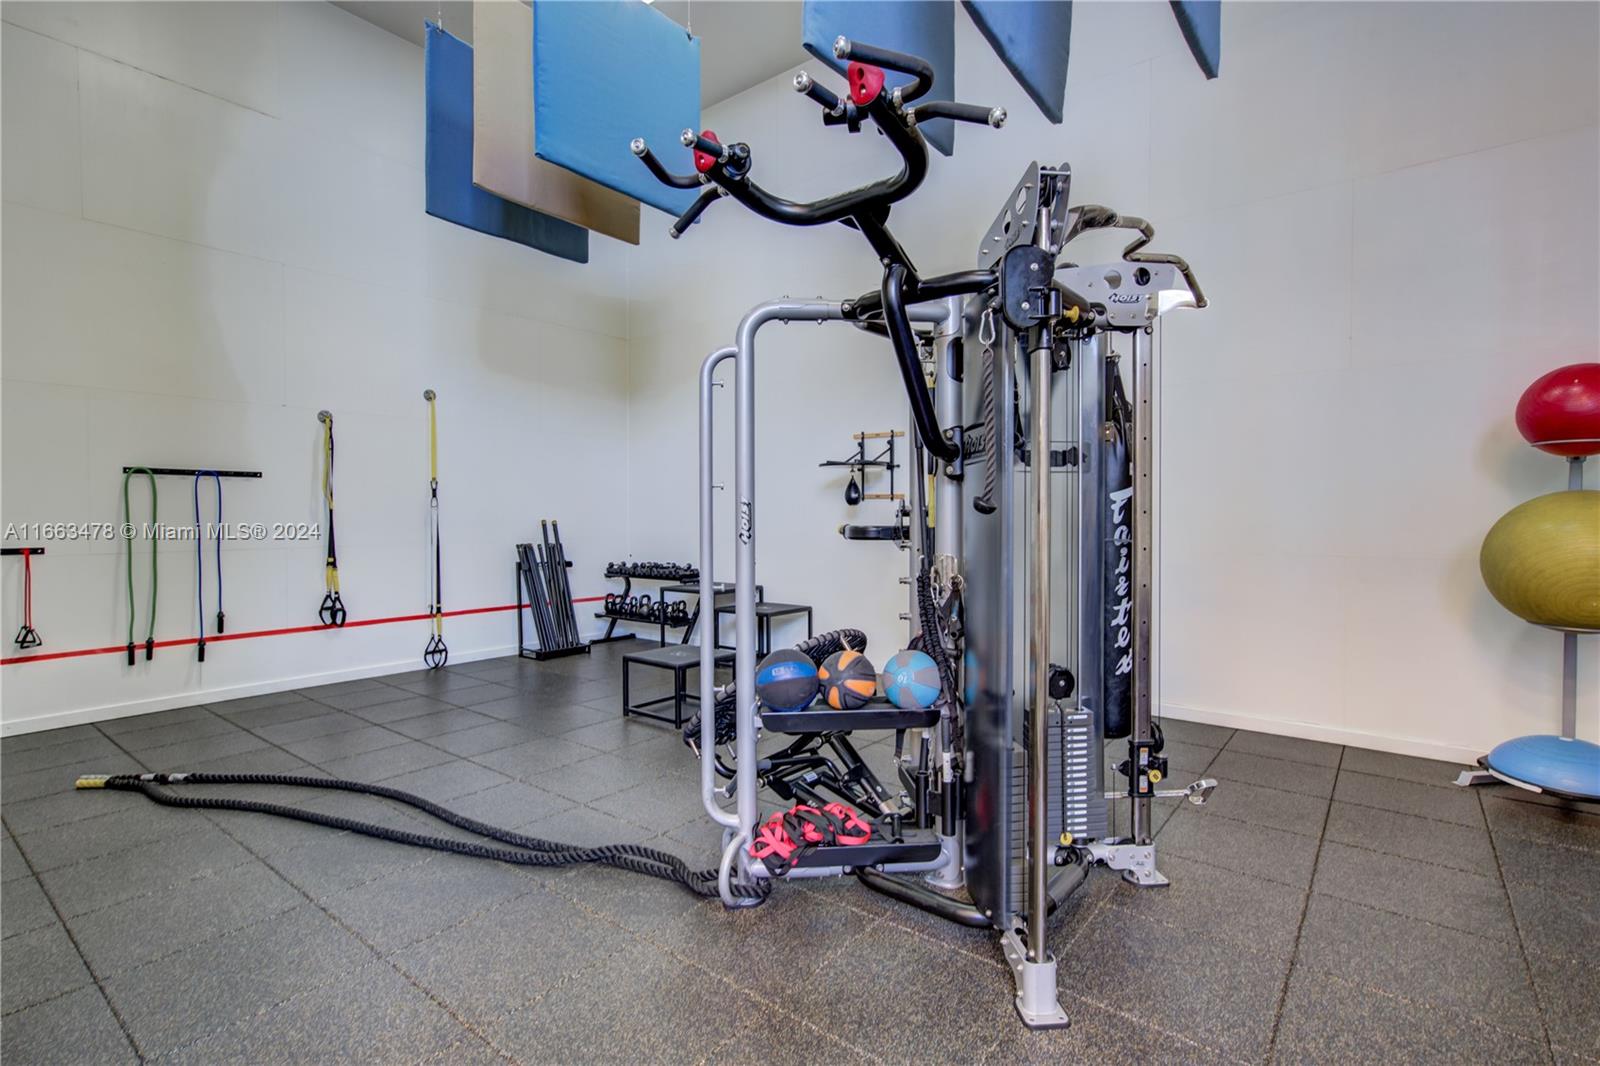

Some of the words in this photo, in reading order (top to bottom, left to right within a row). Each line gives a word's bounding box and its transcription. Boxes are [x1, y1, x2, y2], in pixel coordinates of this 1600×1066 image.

[1108, 292, 1144, 304] HOIST
[739, 497, 752, 545] HOIST
[1109, 485, 1132, 675] Fairtex
